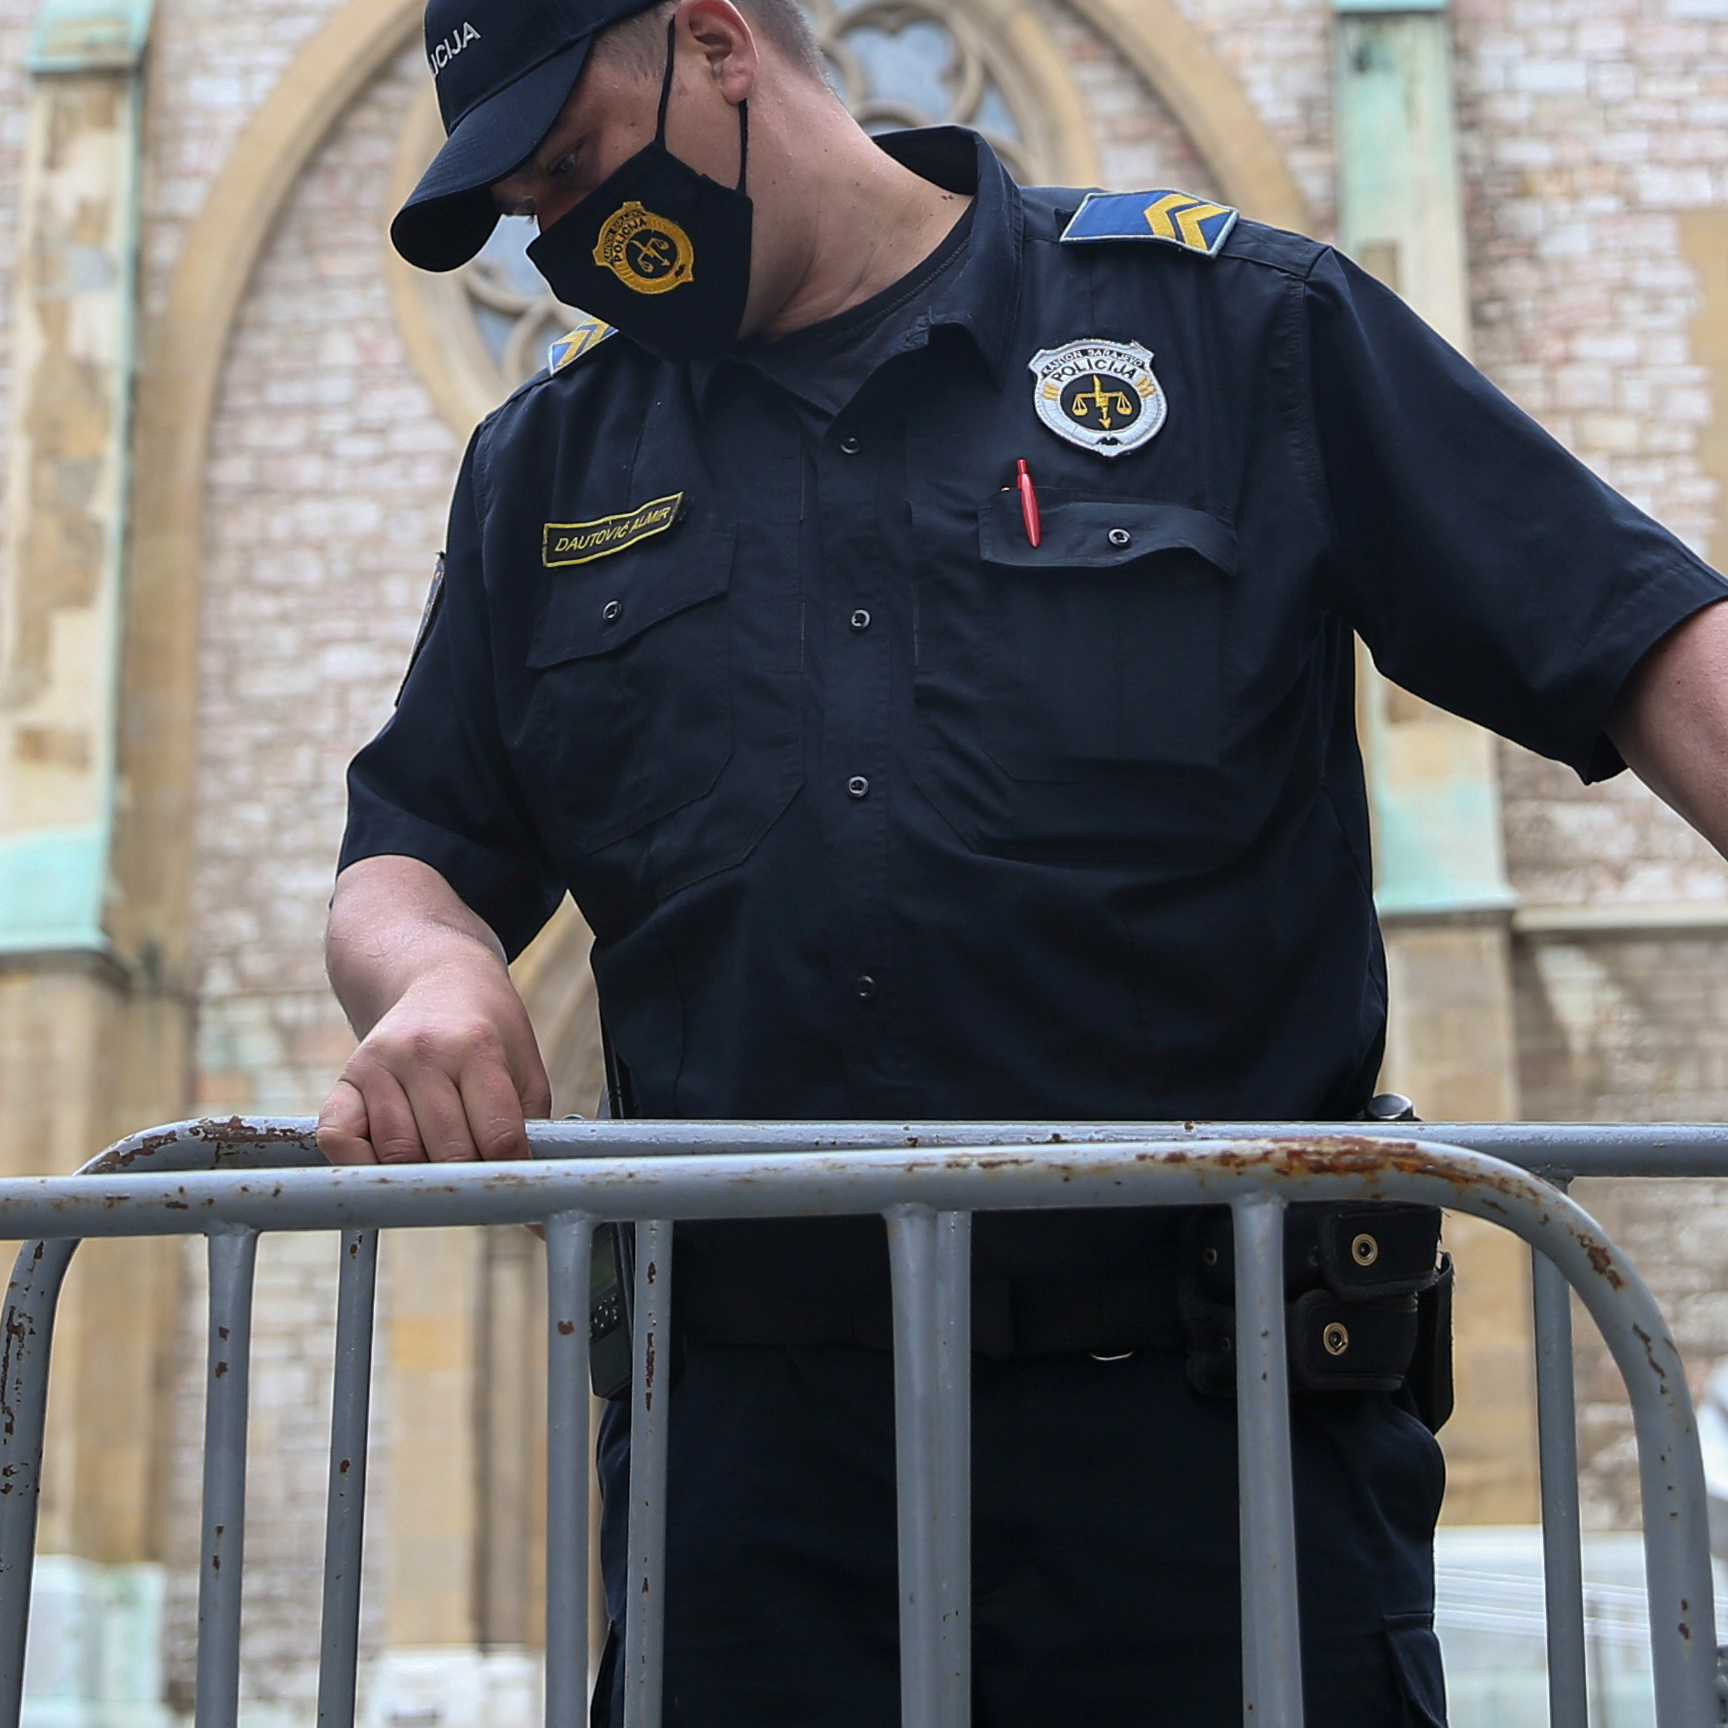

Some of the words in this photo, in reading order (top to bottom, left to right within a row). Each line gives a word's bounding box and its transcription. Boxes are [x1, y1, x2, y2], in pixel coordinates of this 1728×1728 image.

[431, 22, 481, 75] ICIJA
[613, 218, 647, 262] POLICIJA
[1041, 351, 1083, 373] KANTON
[1087, 349, 1143, 367] SARAJEVO
[1051, 359, 1137, 382] POLICIJA
[554, 521, 630, 551] DAUTOVIĆ
[629, 507, 671, 533] ALMIR
